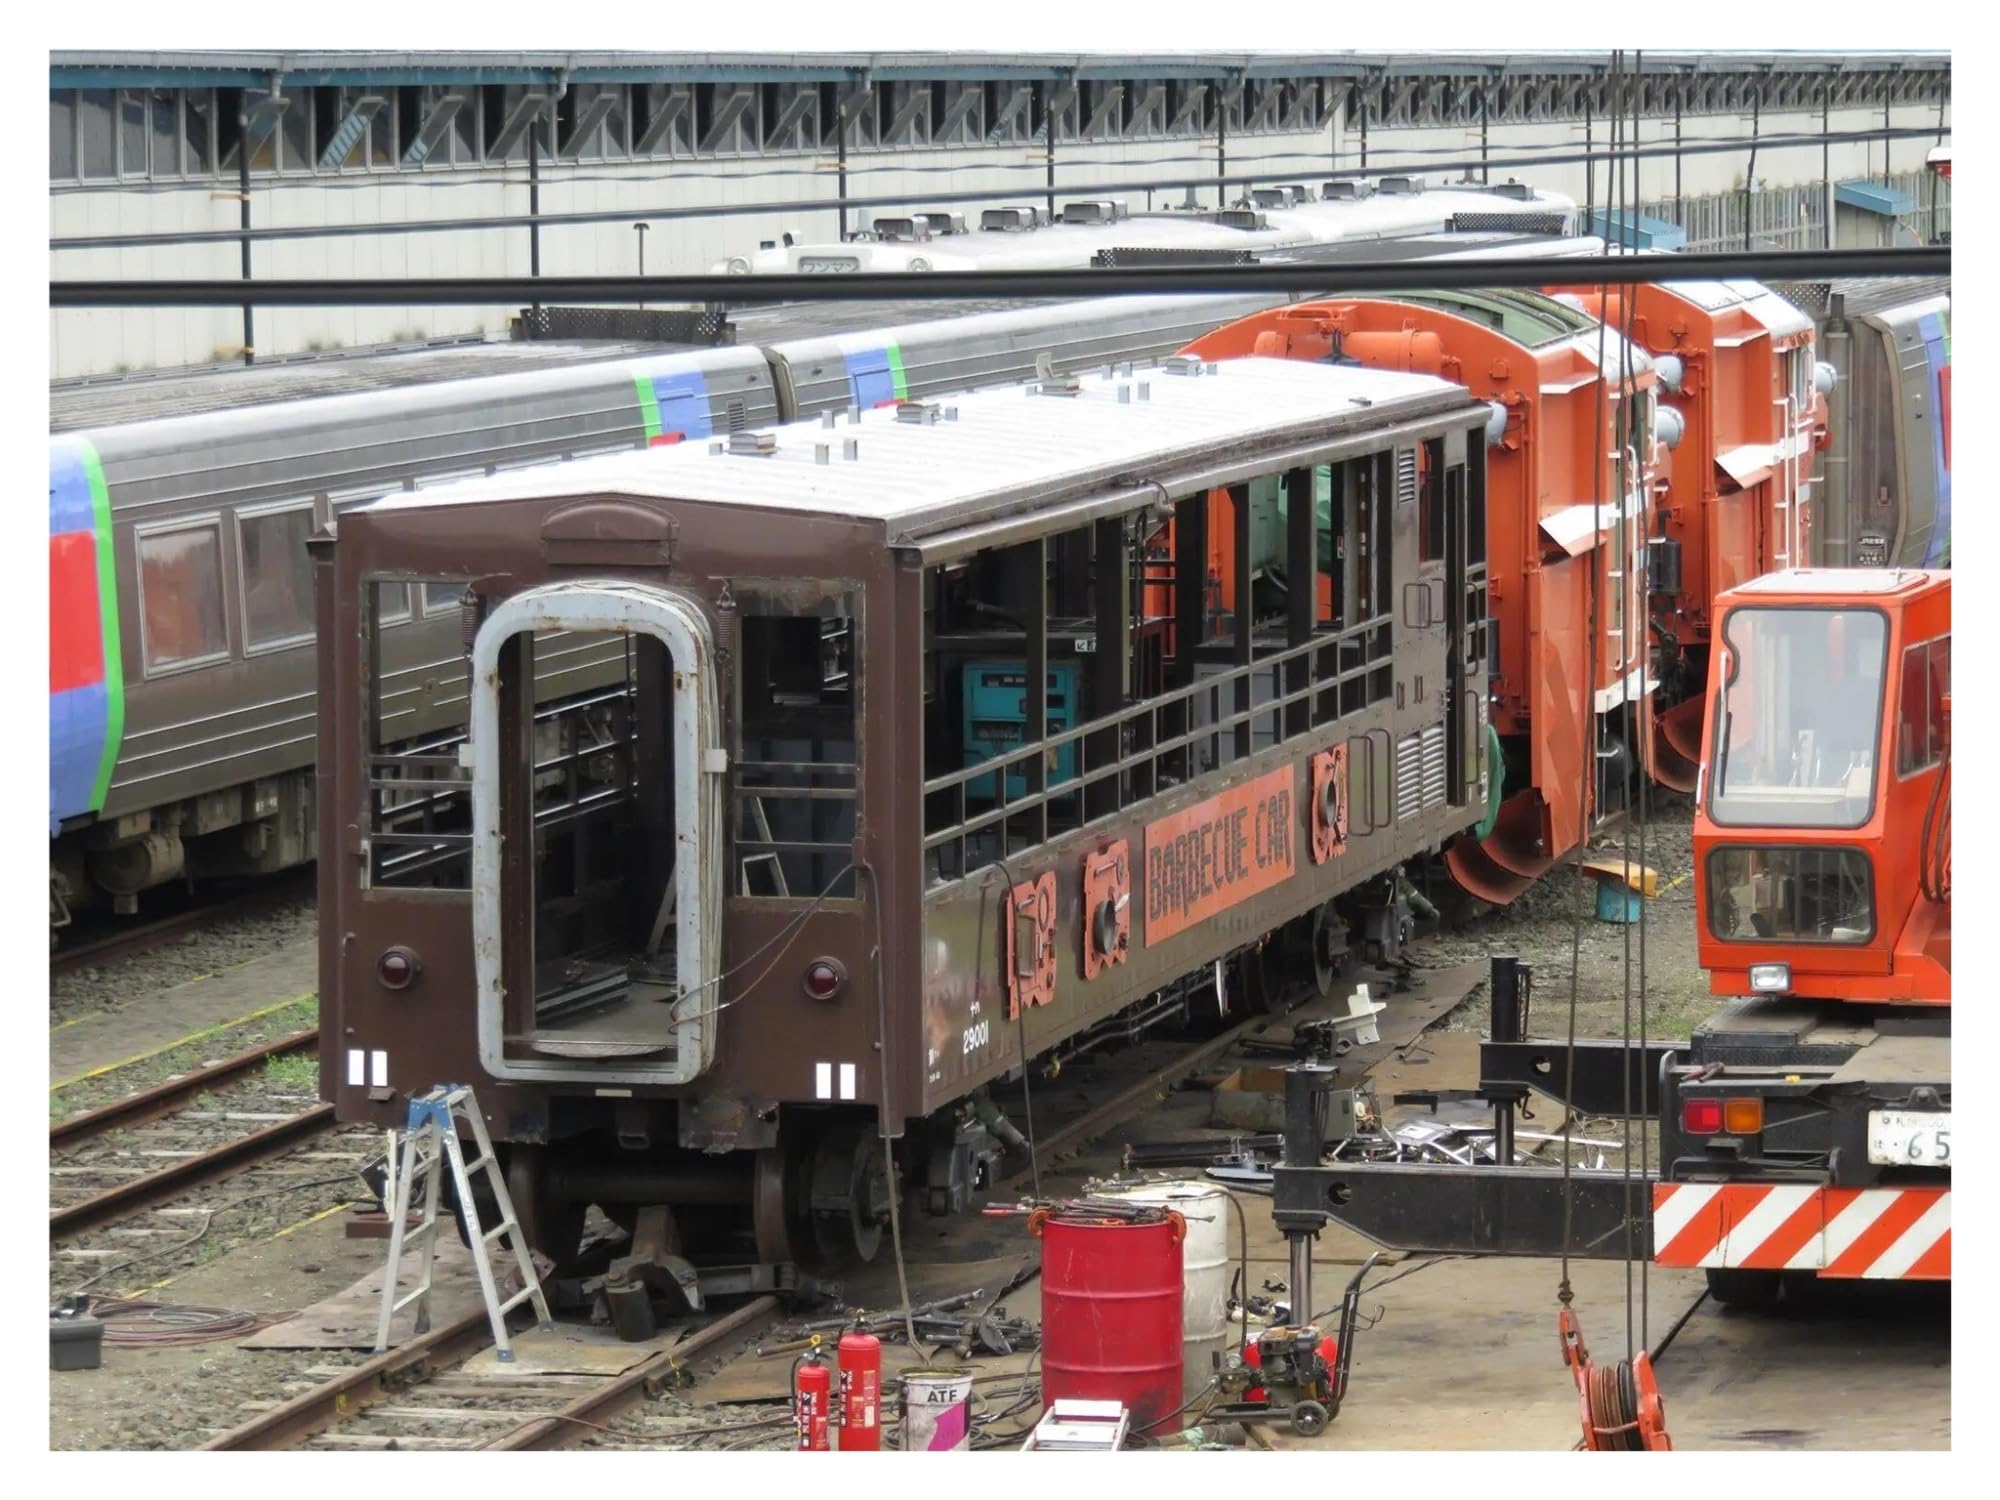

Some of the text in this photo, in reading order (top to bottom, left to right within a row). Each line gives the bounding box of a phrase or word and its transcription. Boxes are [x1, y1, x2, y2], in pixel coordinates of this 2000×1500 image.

[1149, 789, 1292, 923] BARBECUE CAR
[963, 1019, 989, 1054] 29001
[927, 1389, 958, 1402] ATF
